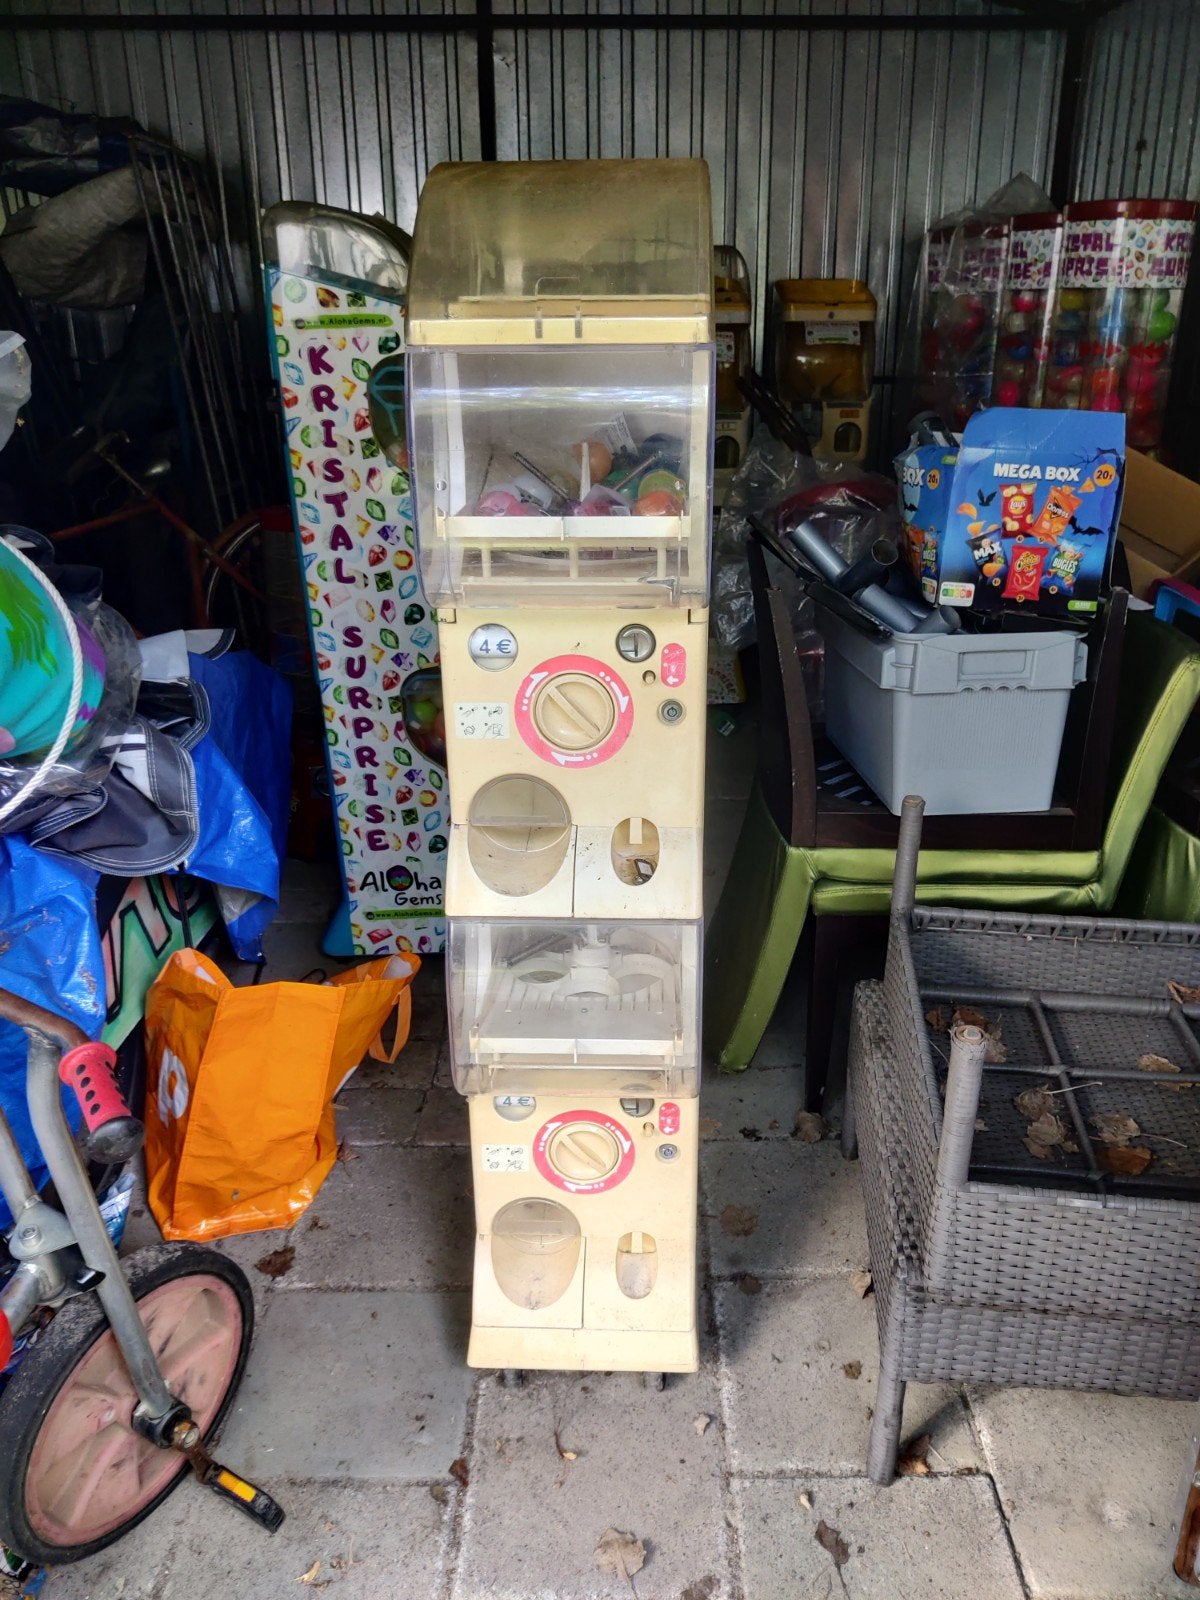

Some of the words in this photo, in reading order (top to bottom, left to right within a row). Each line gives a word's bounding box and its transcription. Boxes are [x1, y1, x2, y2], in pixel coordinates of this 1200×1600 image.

[307, 345, 357, 584] KRISTAL
[993, 462, 1042, 480] MEGA
[1045, 466, 1081, 482] BOX
[973, 541, 1002, 560] MAX
[1053, 557, 1078, 574] BUGLES
[479, 640, 491, 654] 4
[496, 639, 512, 654] €
[342, 625, 390, 852] SURPRISE
[394, 892, 442, 906] Gems
